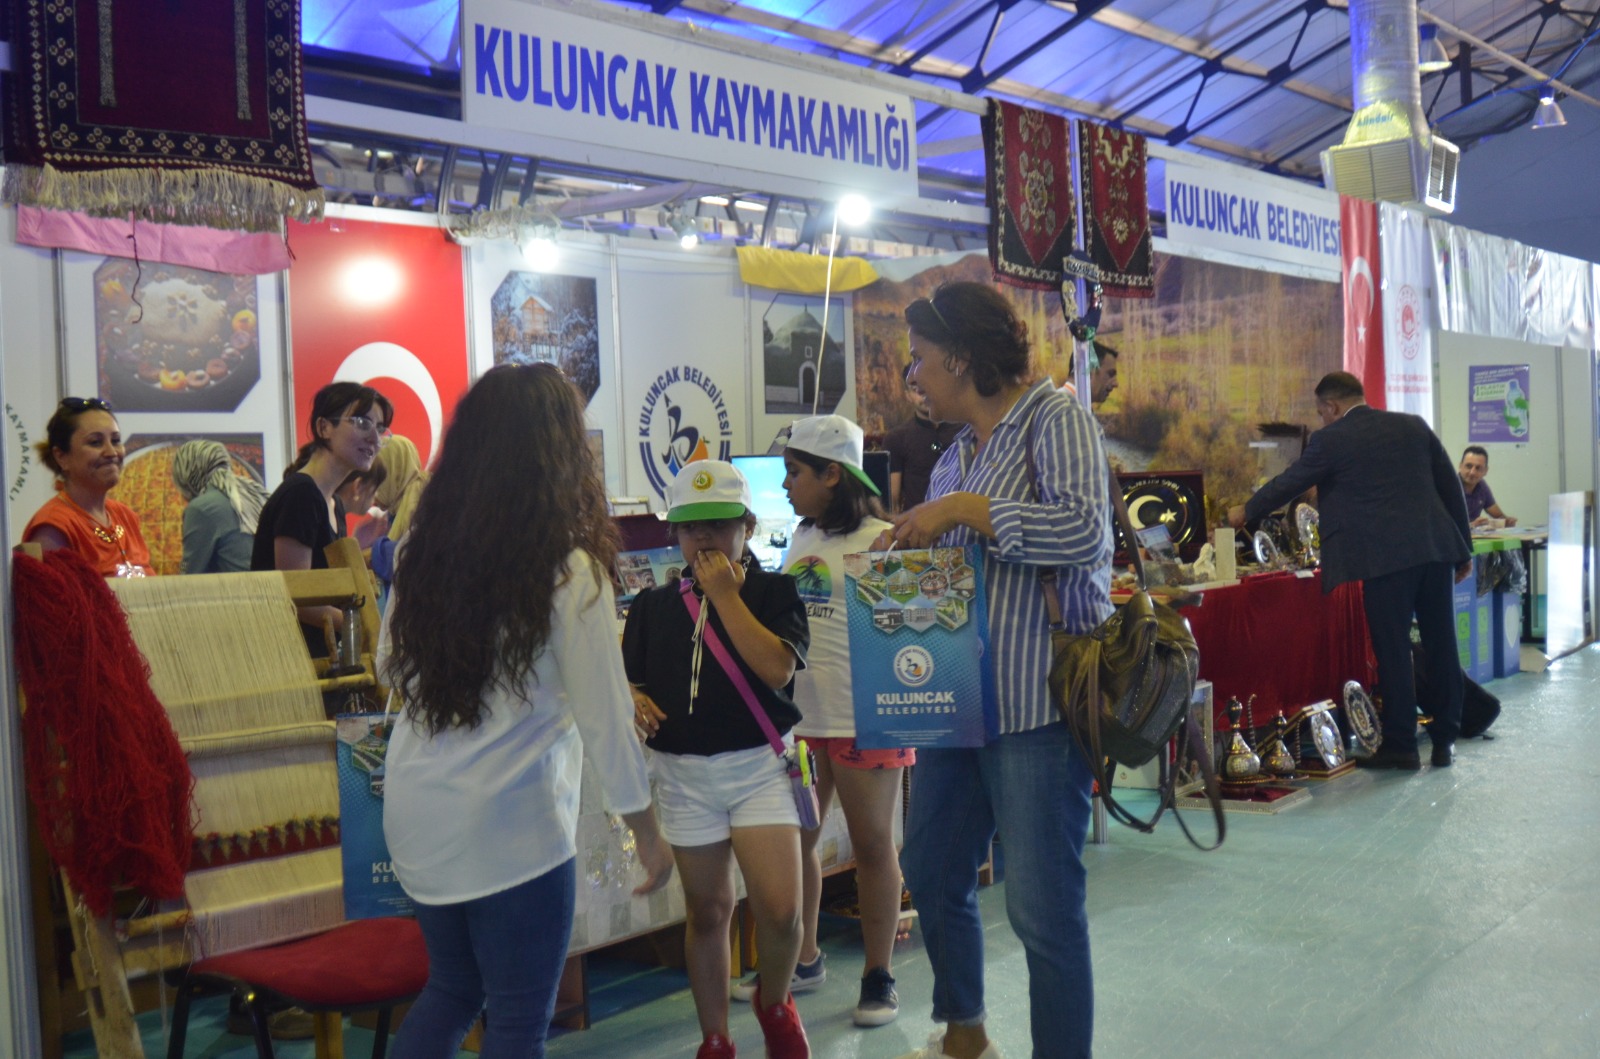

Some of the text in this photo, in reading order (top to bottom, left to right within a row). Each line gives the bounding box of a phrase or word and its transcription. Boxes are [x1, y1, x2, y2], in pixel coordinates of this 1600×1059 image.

[474, 23, 909, 173] KULUNCAK KAYMAKAMLIĞI
[1170, 180, 1261, 241] KULUNCAK
[639, 365, 733, 438] KULUNCAK BELEDİYESİ
[5, 403, 30, 501] KAYMAKAMLI
[807, 606, 835, 619] EAUTY
[876, 691, 955, 705] KULUNCAK
